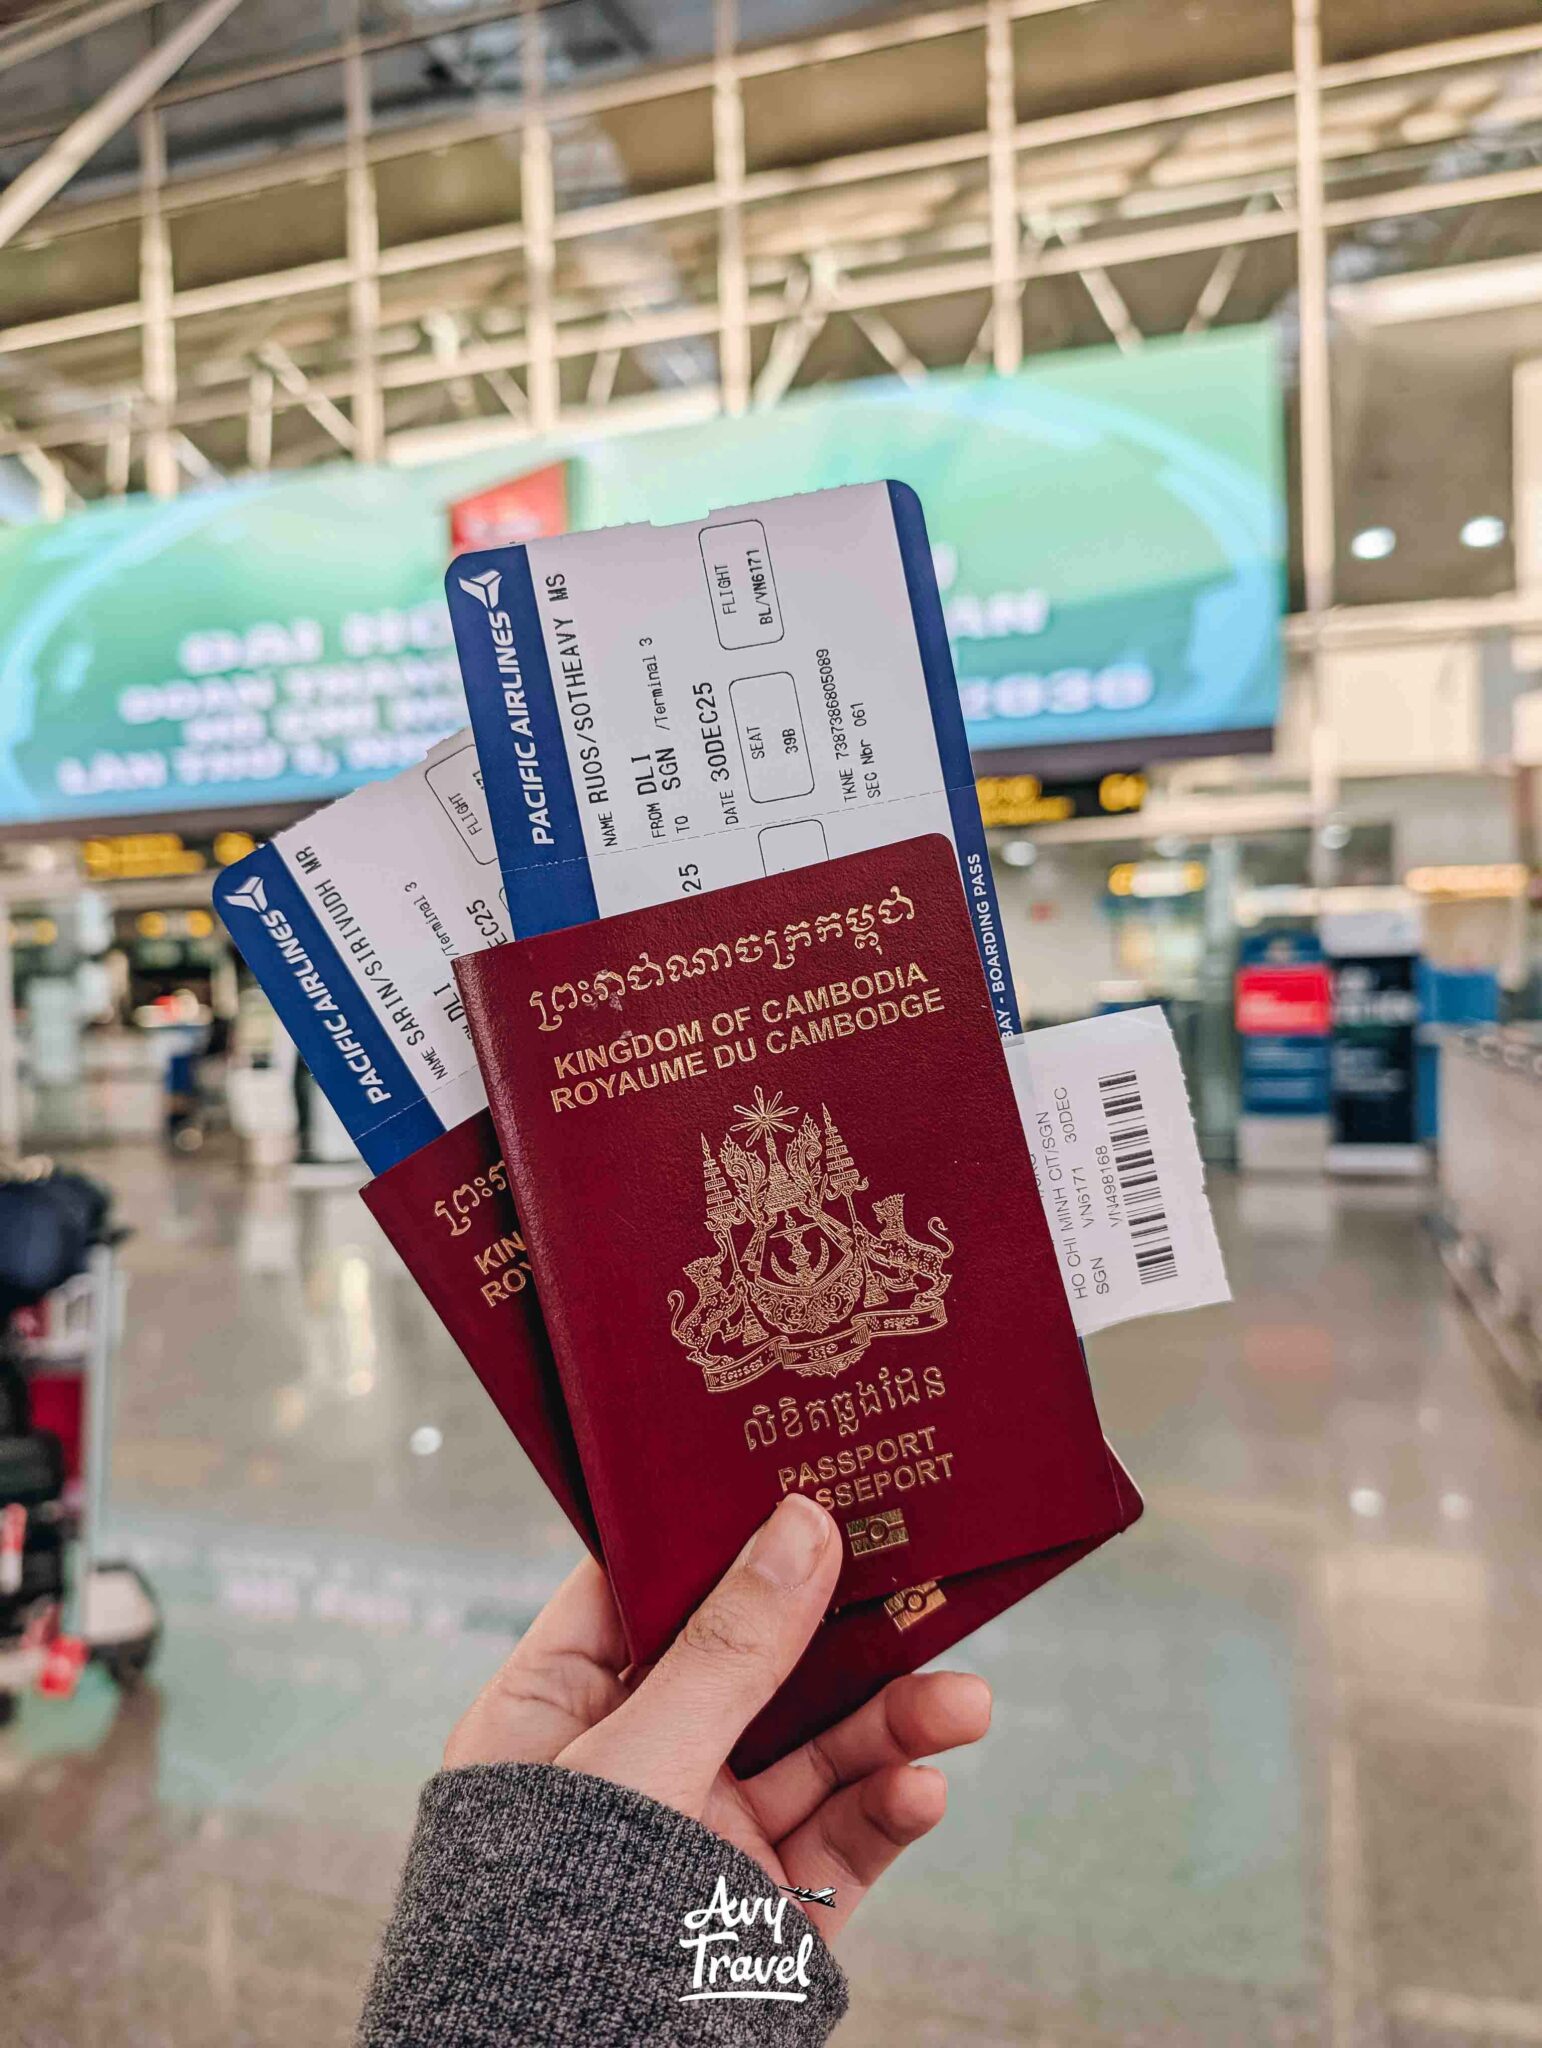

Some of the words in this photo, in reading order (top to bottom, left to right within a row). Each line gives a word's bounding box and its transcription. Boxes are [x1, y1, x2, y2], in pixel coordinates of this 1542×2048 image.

[545, 573, 569, 602] MS
[713, 564, 737, 615] FLIGHT
[746, 549, 774, 625] BL/VN6171
[639, 636, 653, 647] 3
[487, 609, 535, 738] AIRLINES
[642, 653, 671, 731] /Terminal
[553, 618, 609, 804] RUOS/SOTHEAVY
[693, 682, 730, 782] 30DEC25
[850, 702, 867, 727] 061
[746, 725, 765, 760] SEAT
[782, 728, 799, 755] 39B
[860, 739, 876, 765] Nbr
[631, 754, 658, 796] DLI
[655, 747, 681, 791] SGN
[839, 767, 857, 802] TKNE
[864, 772, 882, 799] SEC
[448, 793, 482, 835] FLIGHT
[513, 741, 555, 846] PACIFIC
[719, 789, 740, 826] DATE
[598, 811, 618, 847] NAME
[647, 802, 666, 839] FROM
[674, 815, 691, 834] TO
[295, 845, 323, 874] MR
[967, 853, 987, 897] PASS
[404, 881, 417, 893] 3
[413, 895, 459, 956] /Terminal
[466, 899, 508, 948] EC25
[262, 908, 337, 1012] AIRLINES
[314, 878, 426, 1047] SARIN/SIRIVUDH
[977, 900, 1006, 993] BOARDING
[554, 1021, 704, 1079] KINGDOM
[711, 1005, 751, 1037] OF
[761, 962, 929, 1025] CAMBODIA
[323, 1012, 392, 1105] PACIFIC
[421, 1046, 448, 1080] NAME
[550, 1048, 707, 1112] ROYAUME
[713, 1038, 757, 1069] DU
[765, 987, 945, 1055] CAMBODGE
[1054, 1087, 1077, 1143] 30DEC
[1036, 1111, 1063, 1181] CIT/SGN
[1071, 1166, 1095, 1229] VN6171
[1095, 1145, 1123, 1228] VN498168
[1053, 1187, 1074, 1232] MINH
[1063, 1237, 1081, 1267] CHI
[1071, 1273, 1088, 1300] HO
[1090, 1257, 1110, 1295] SGN
[778, 1426, 936, 1492] PASSPORT
[815, 1452, 954, 1511] SSEPORT
